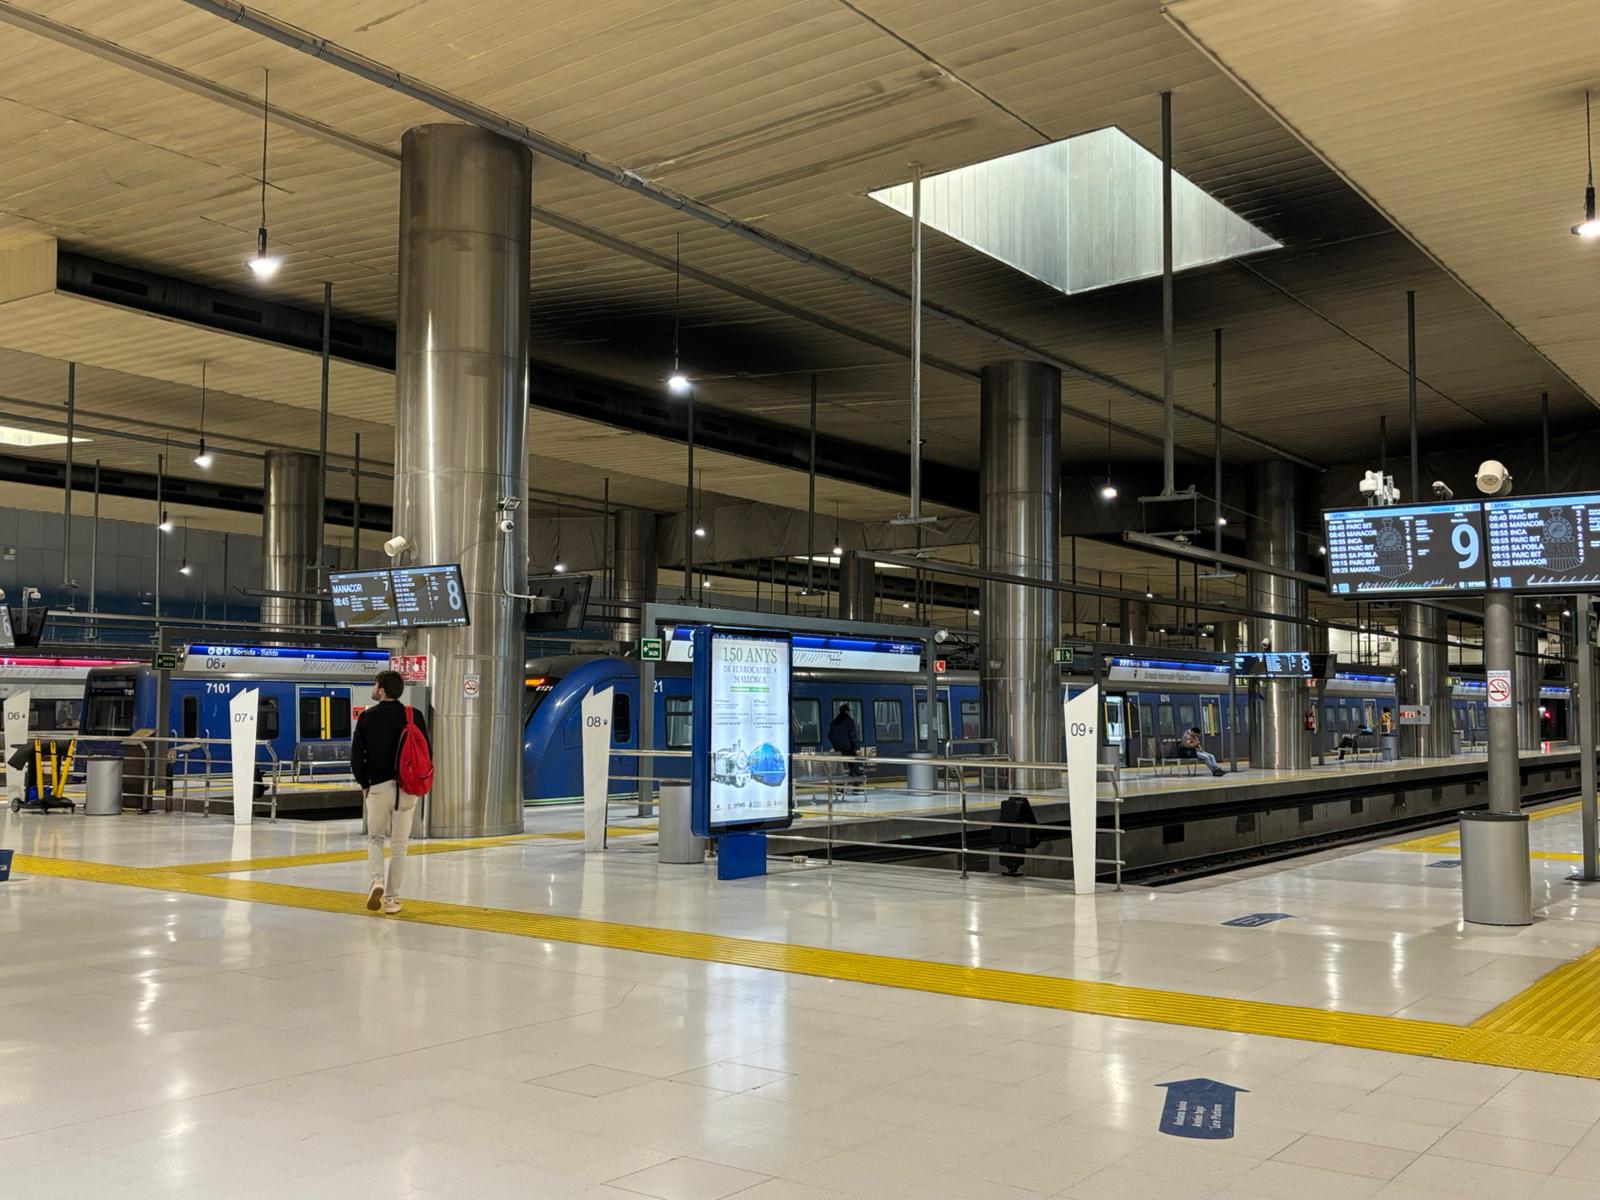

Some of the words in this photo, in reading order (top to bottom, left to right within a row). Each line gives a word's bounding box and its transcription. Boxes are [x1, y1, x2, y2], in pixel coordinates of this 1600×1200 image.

[1510, 520, 1545, 528] MANACOR
[1510, 528, 1528, 536] INCA
[1452, 524, 1479, 569] 9
[1512, 558, 1548, 566] MANACOR
[1579, 556, 1584, 564] 7
[332, 583, 363, 594] MANACOR
[383, 581, 389, 592] 7
[447, 579, 462, 610] 8
[3, 616, 11, 637] 6
[232, 648, 256, 656] Sortida
[260, 648, 279, 656] Salida
[723, 646, 743, 662] 150
[746, 648, 778, 664] ANYS
[206, 658, 220, 669] 06
[724, 665, 730, 673] DE
[1301, 658, 1310, 672] 8
[734, 675, 767, 684] MALLORCA
[206, 683, 230, 694] 7101
[8, 712, 20, 720] 06
[234, 713, 248, 723] 07
[586, 715, 600, 728] 08
[1070, 722, 1086, 736] 09
